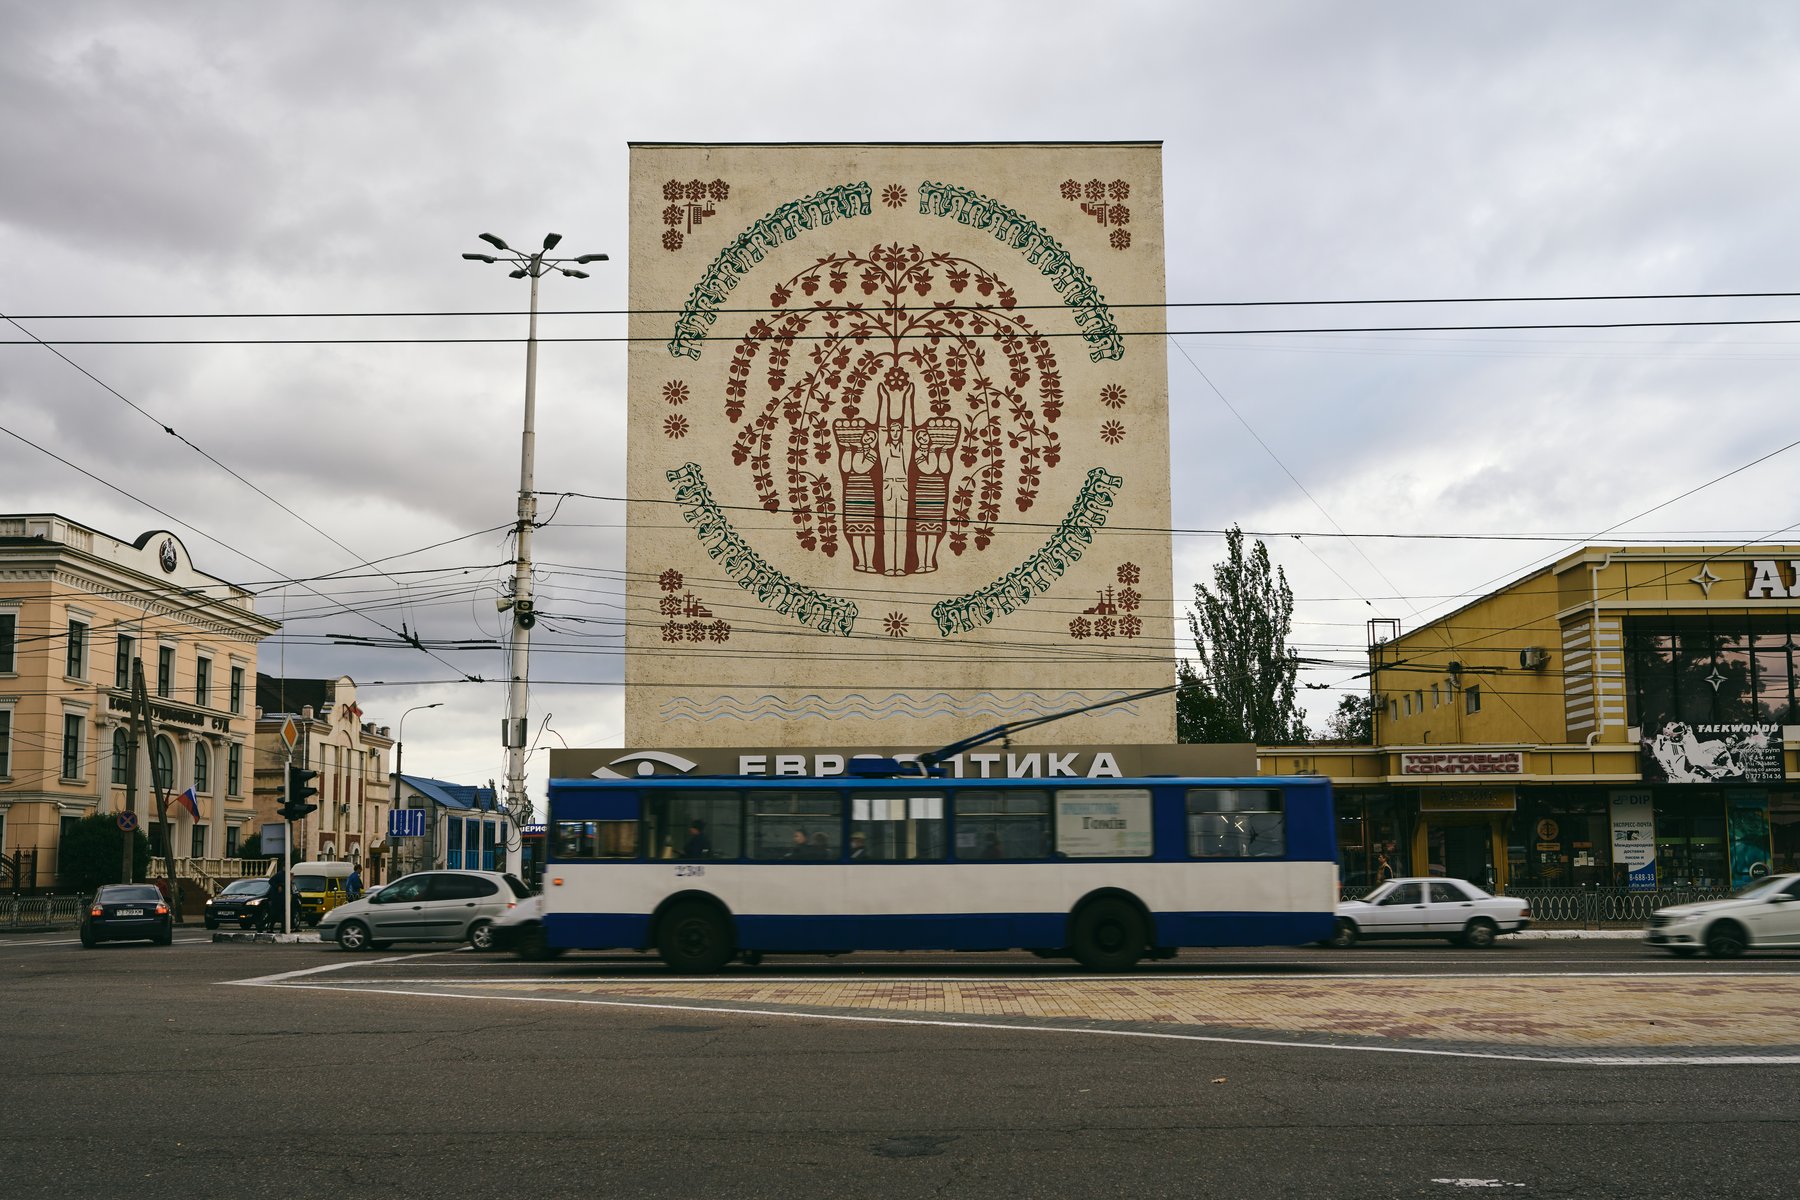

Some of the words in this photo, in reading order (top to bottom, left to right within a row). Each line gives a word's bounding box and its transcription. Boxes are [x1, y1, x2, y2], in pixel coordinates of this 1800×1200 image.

[211, 718, 230, 734] СУД
[1697, 724, 1780, 733] TAEKWONDO
[1405, 753, 1520, 764] ТОРГОВЫЙ
[739, 752, 1123, 778] ЕВРПТИКА
[1405, 764, 1520, 774] КОМПЛЕКС
[1630, 795, 1650, 804] DIP
